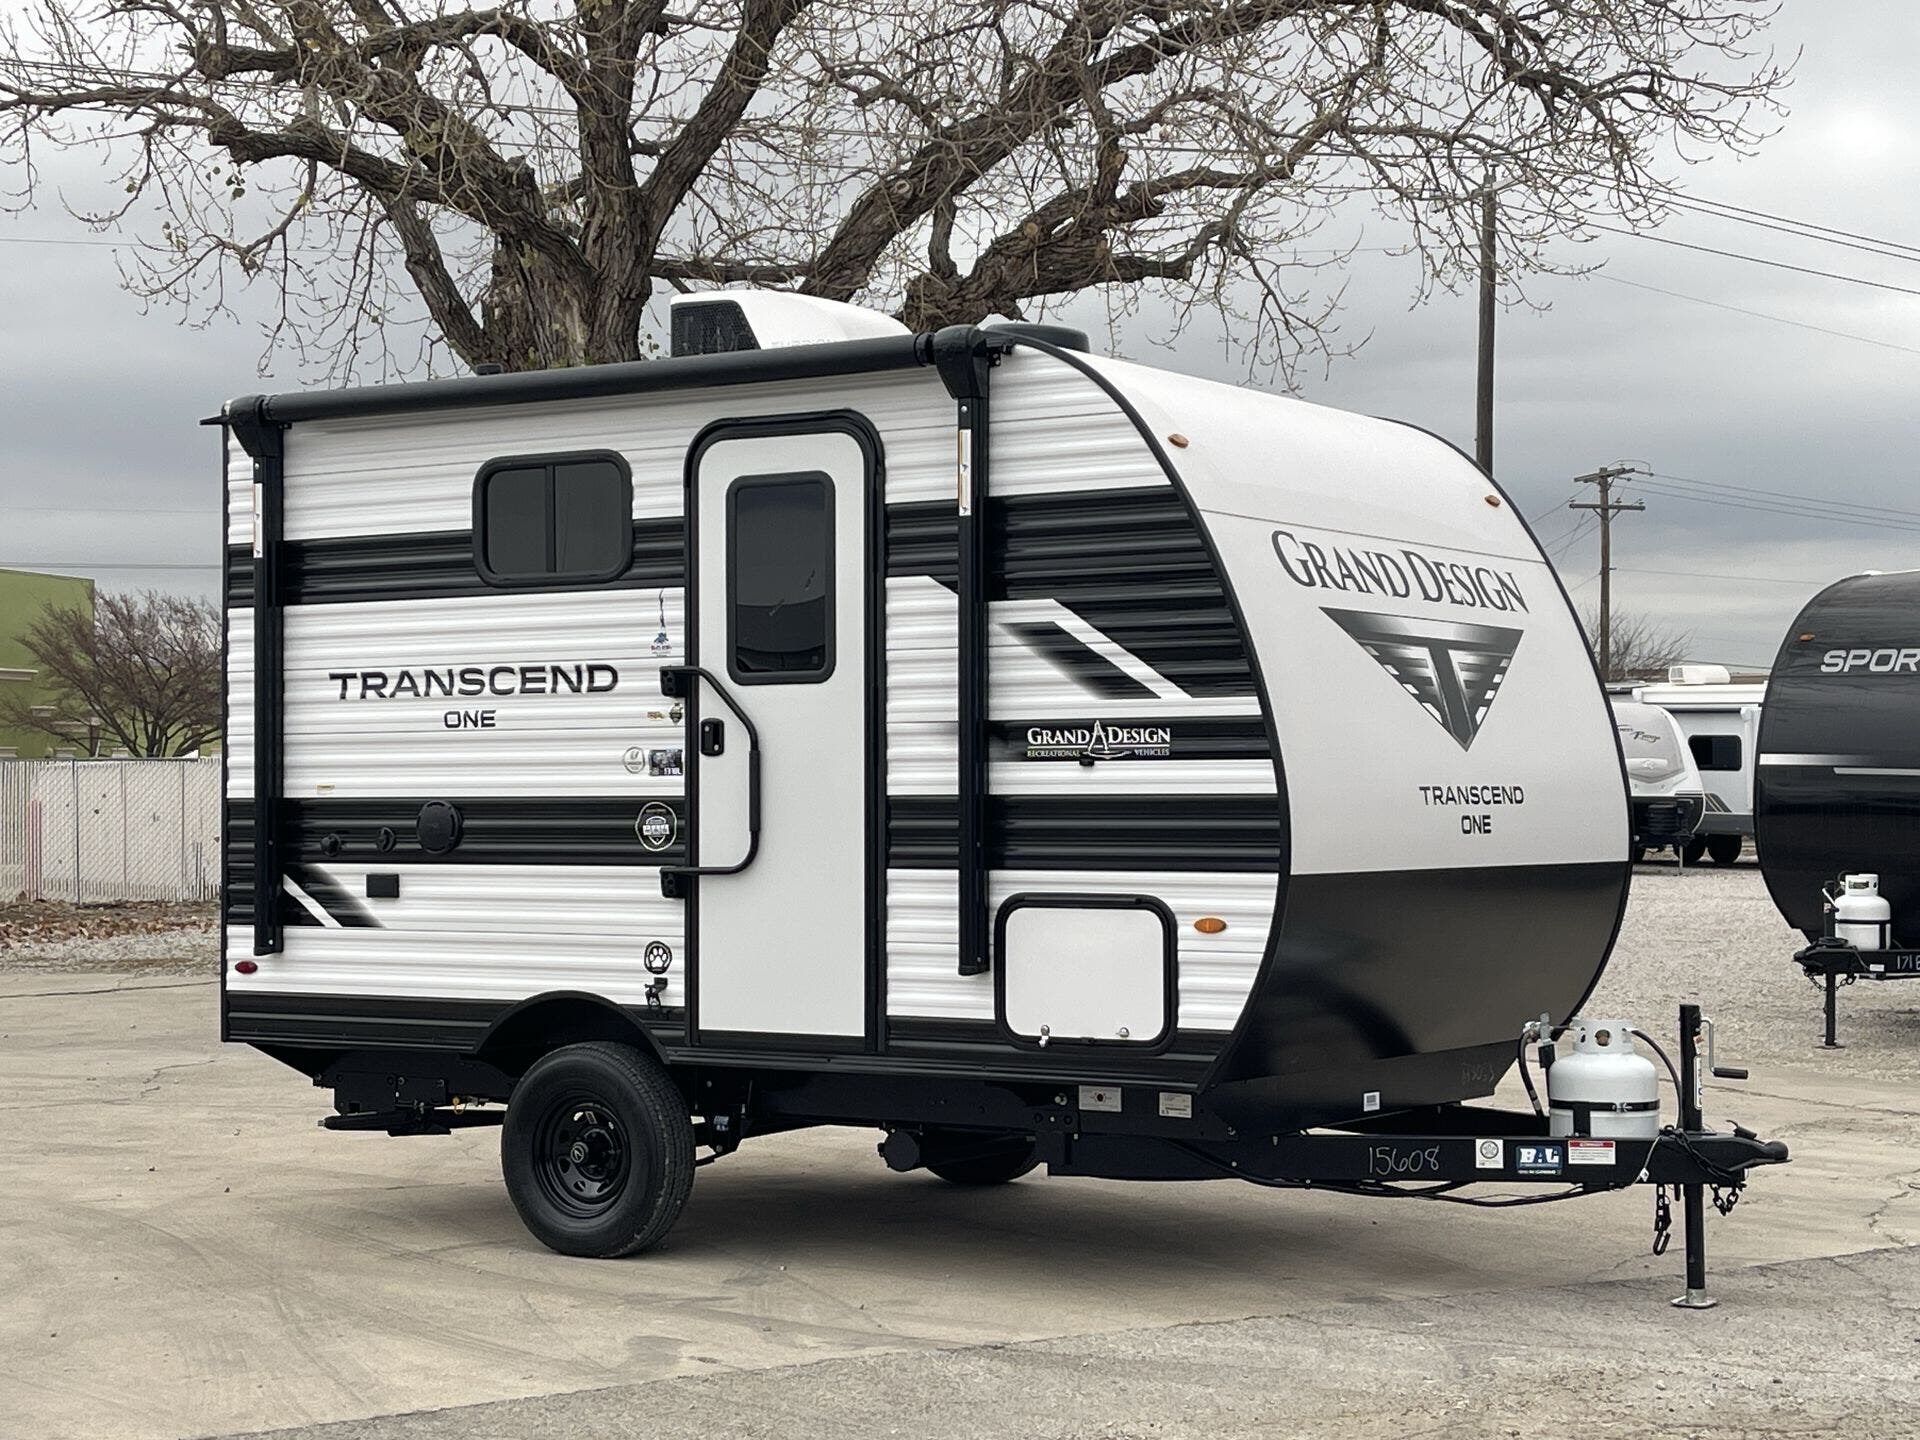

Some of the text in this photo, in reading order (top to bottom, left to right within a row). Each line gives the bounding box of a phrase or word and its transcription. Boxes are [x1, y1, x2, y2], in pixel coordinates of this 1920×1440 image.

[1271, 529, 1530, 614] GRAND DESIGN
[328, 664, 619, 700] TRANSCEND
[443, 709, 497, 729] ONE
[1026, 726, 1171, 745] GRAND DESIGN
[1418, 785, 1525, 806] TRANSCEND
[1461, 814, 1492, 835] ONE
[1368, 1144, 1441, 1176] 15608
